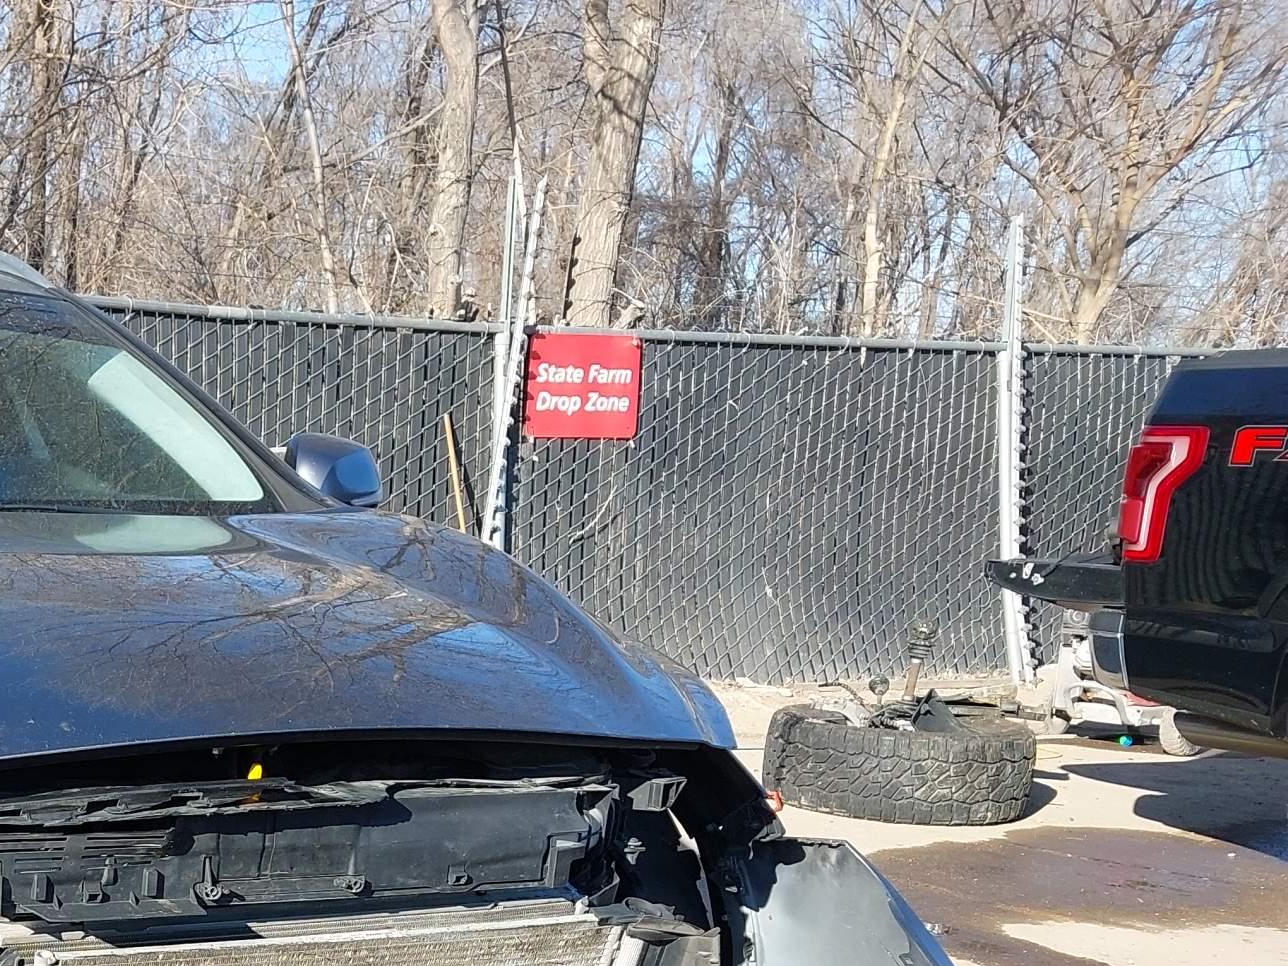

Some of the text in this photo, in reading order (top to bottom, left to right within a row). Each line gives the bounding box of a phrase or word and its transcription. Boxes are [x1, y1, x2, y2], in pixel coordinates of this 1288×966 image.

[535, 363, 633, 384] State Farm
[535, 392, 630, 416] Drop Zone
